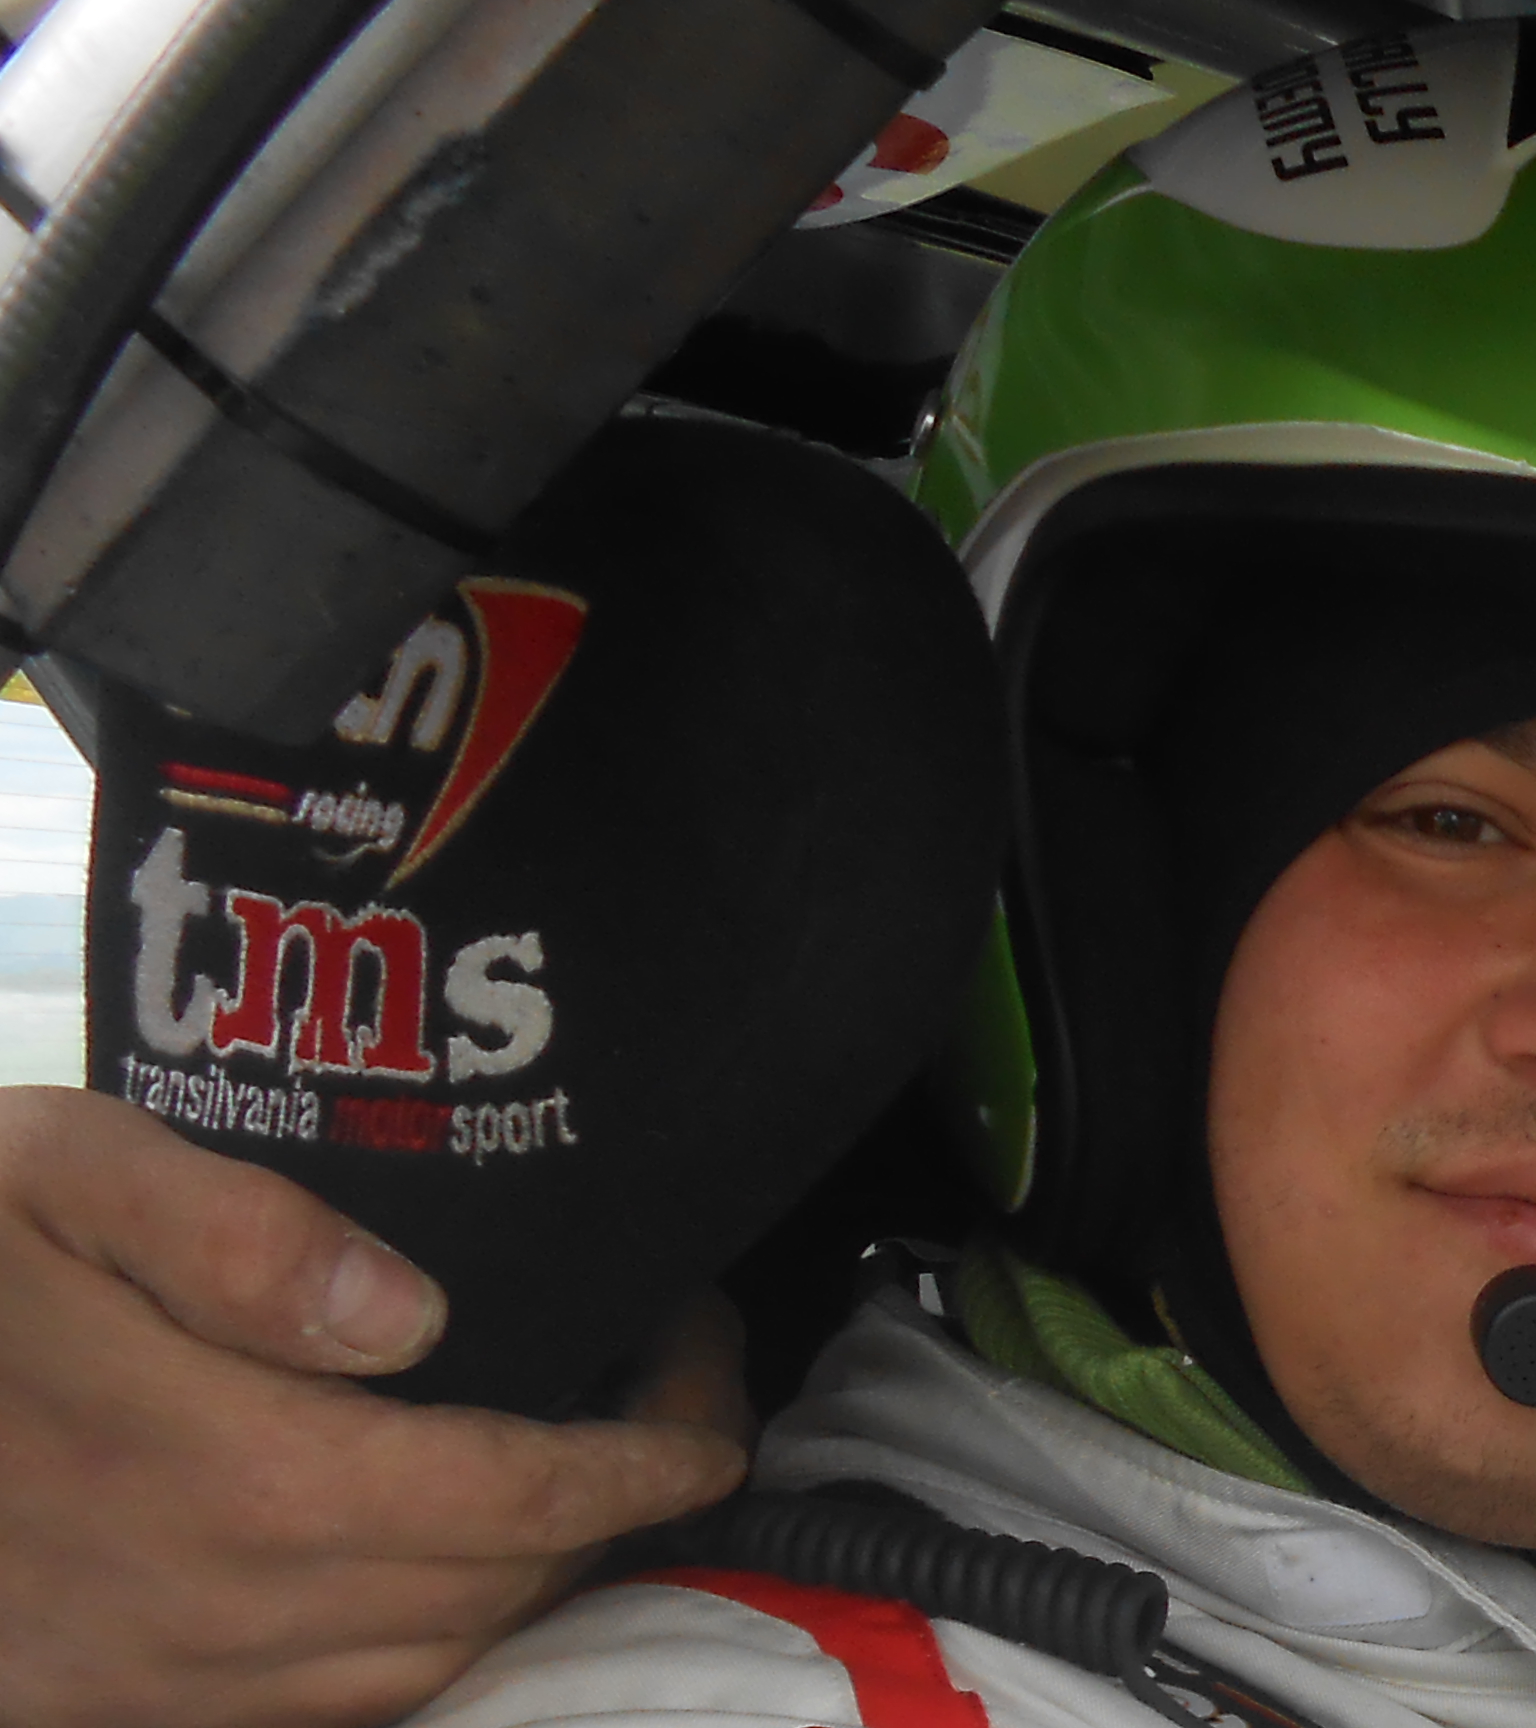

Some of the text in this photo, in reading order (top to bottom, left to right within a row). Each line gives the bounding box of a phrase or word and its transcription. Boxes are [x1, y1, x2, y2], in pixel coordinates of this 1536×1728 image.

[1340, 34, 1446, 145] ALLY
[129, 826, 554, 1084] tms
[121, 1053, 320, 1141] transilvania
